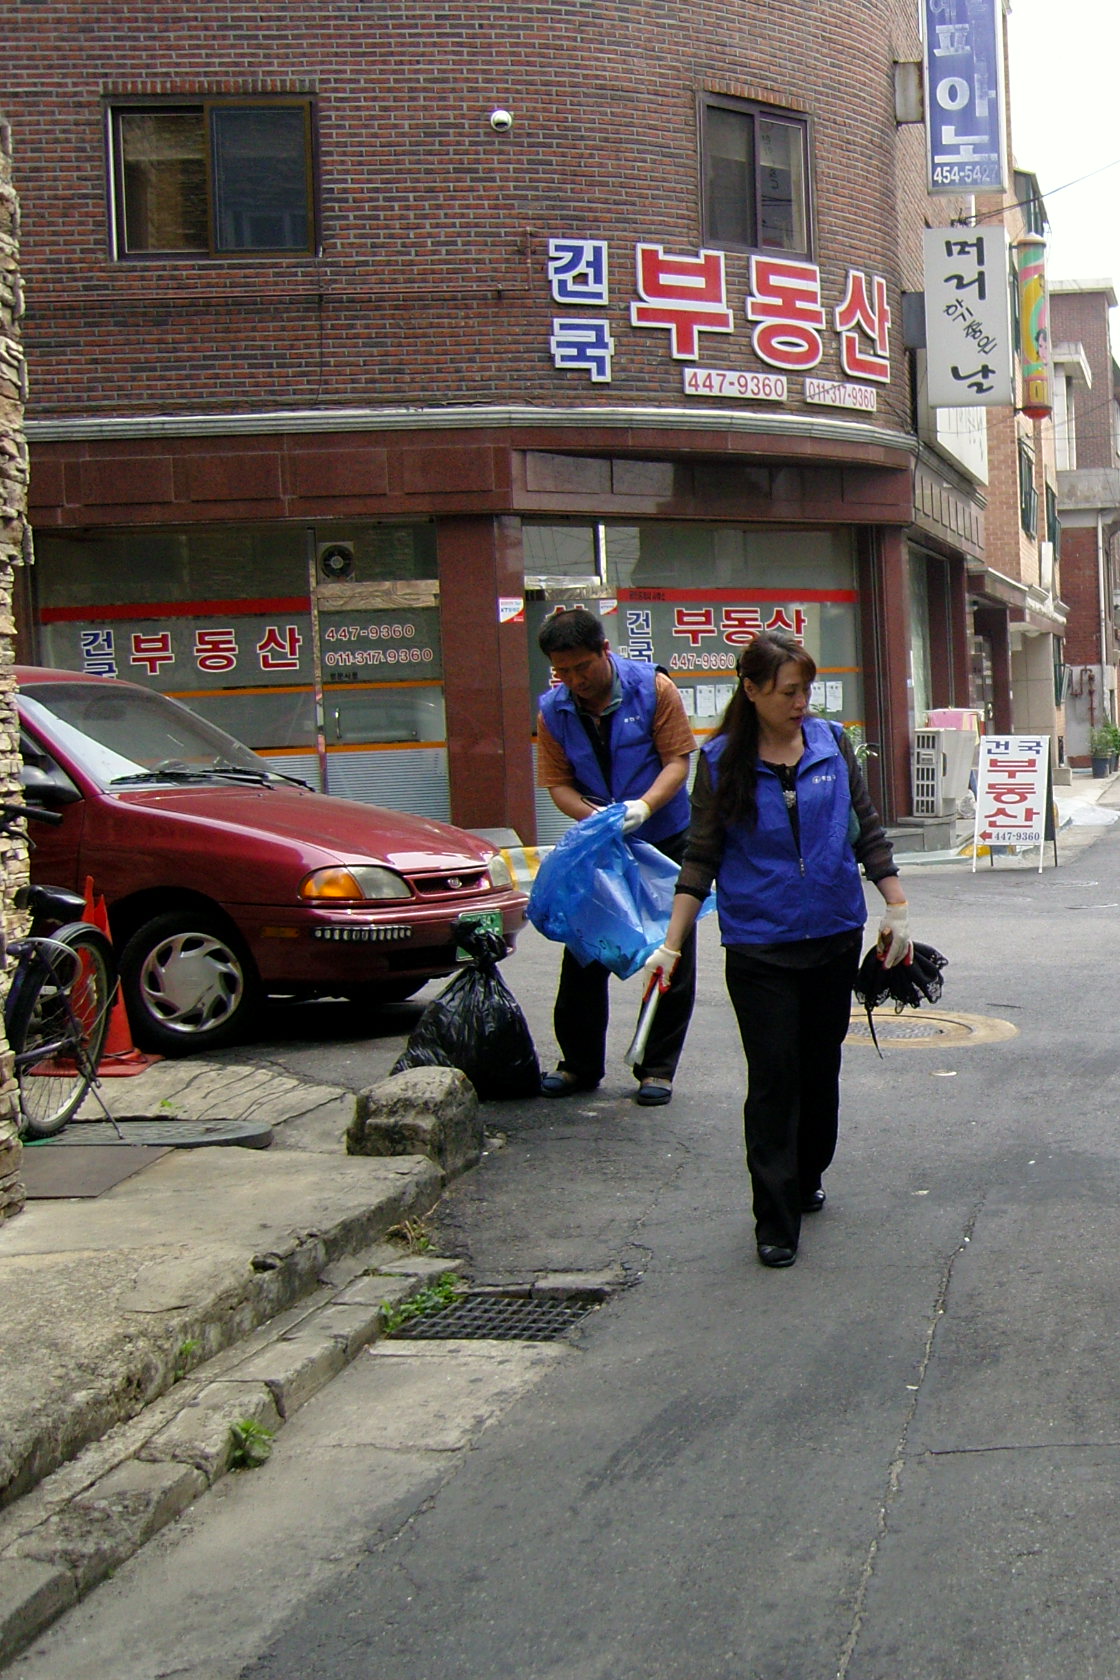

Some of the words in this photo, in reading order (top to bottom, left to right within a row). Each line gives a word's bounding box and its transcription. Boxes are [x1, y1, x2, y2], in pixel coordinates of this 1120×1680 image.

[934, 166, 996, 184] 454-5427
[944, 236, 986, 300] 머리
[548, 239, 615, 382] 건국
[630, 243, 892, 383] 부동산
[687, 370, 786, 399] 447-9360
[951, 363, 997, 394] 날
[808, 379, 876, 410] 011-317-9360
[325, 624, 416, 642] 447-9360
[130, 625, 303, 677] 부동산
[670, 653, 737, 670] 447-9360
[985, 740, 1043, 755] 건국
[984, 758, 1040, 828] 부동산
[994, 831, 1040, 842] 447-9360
